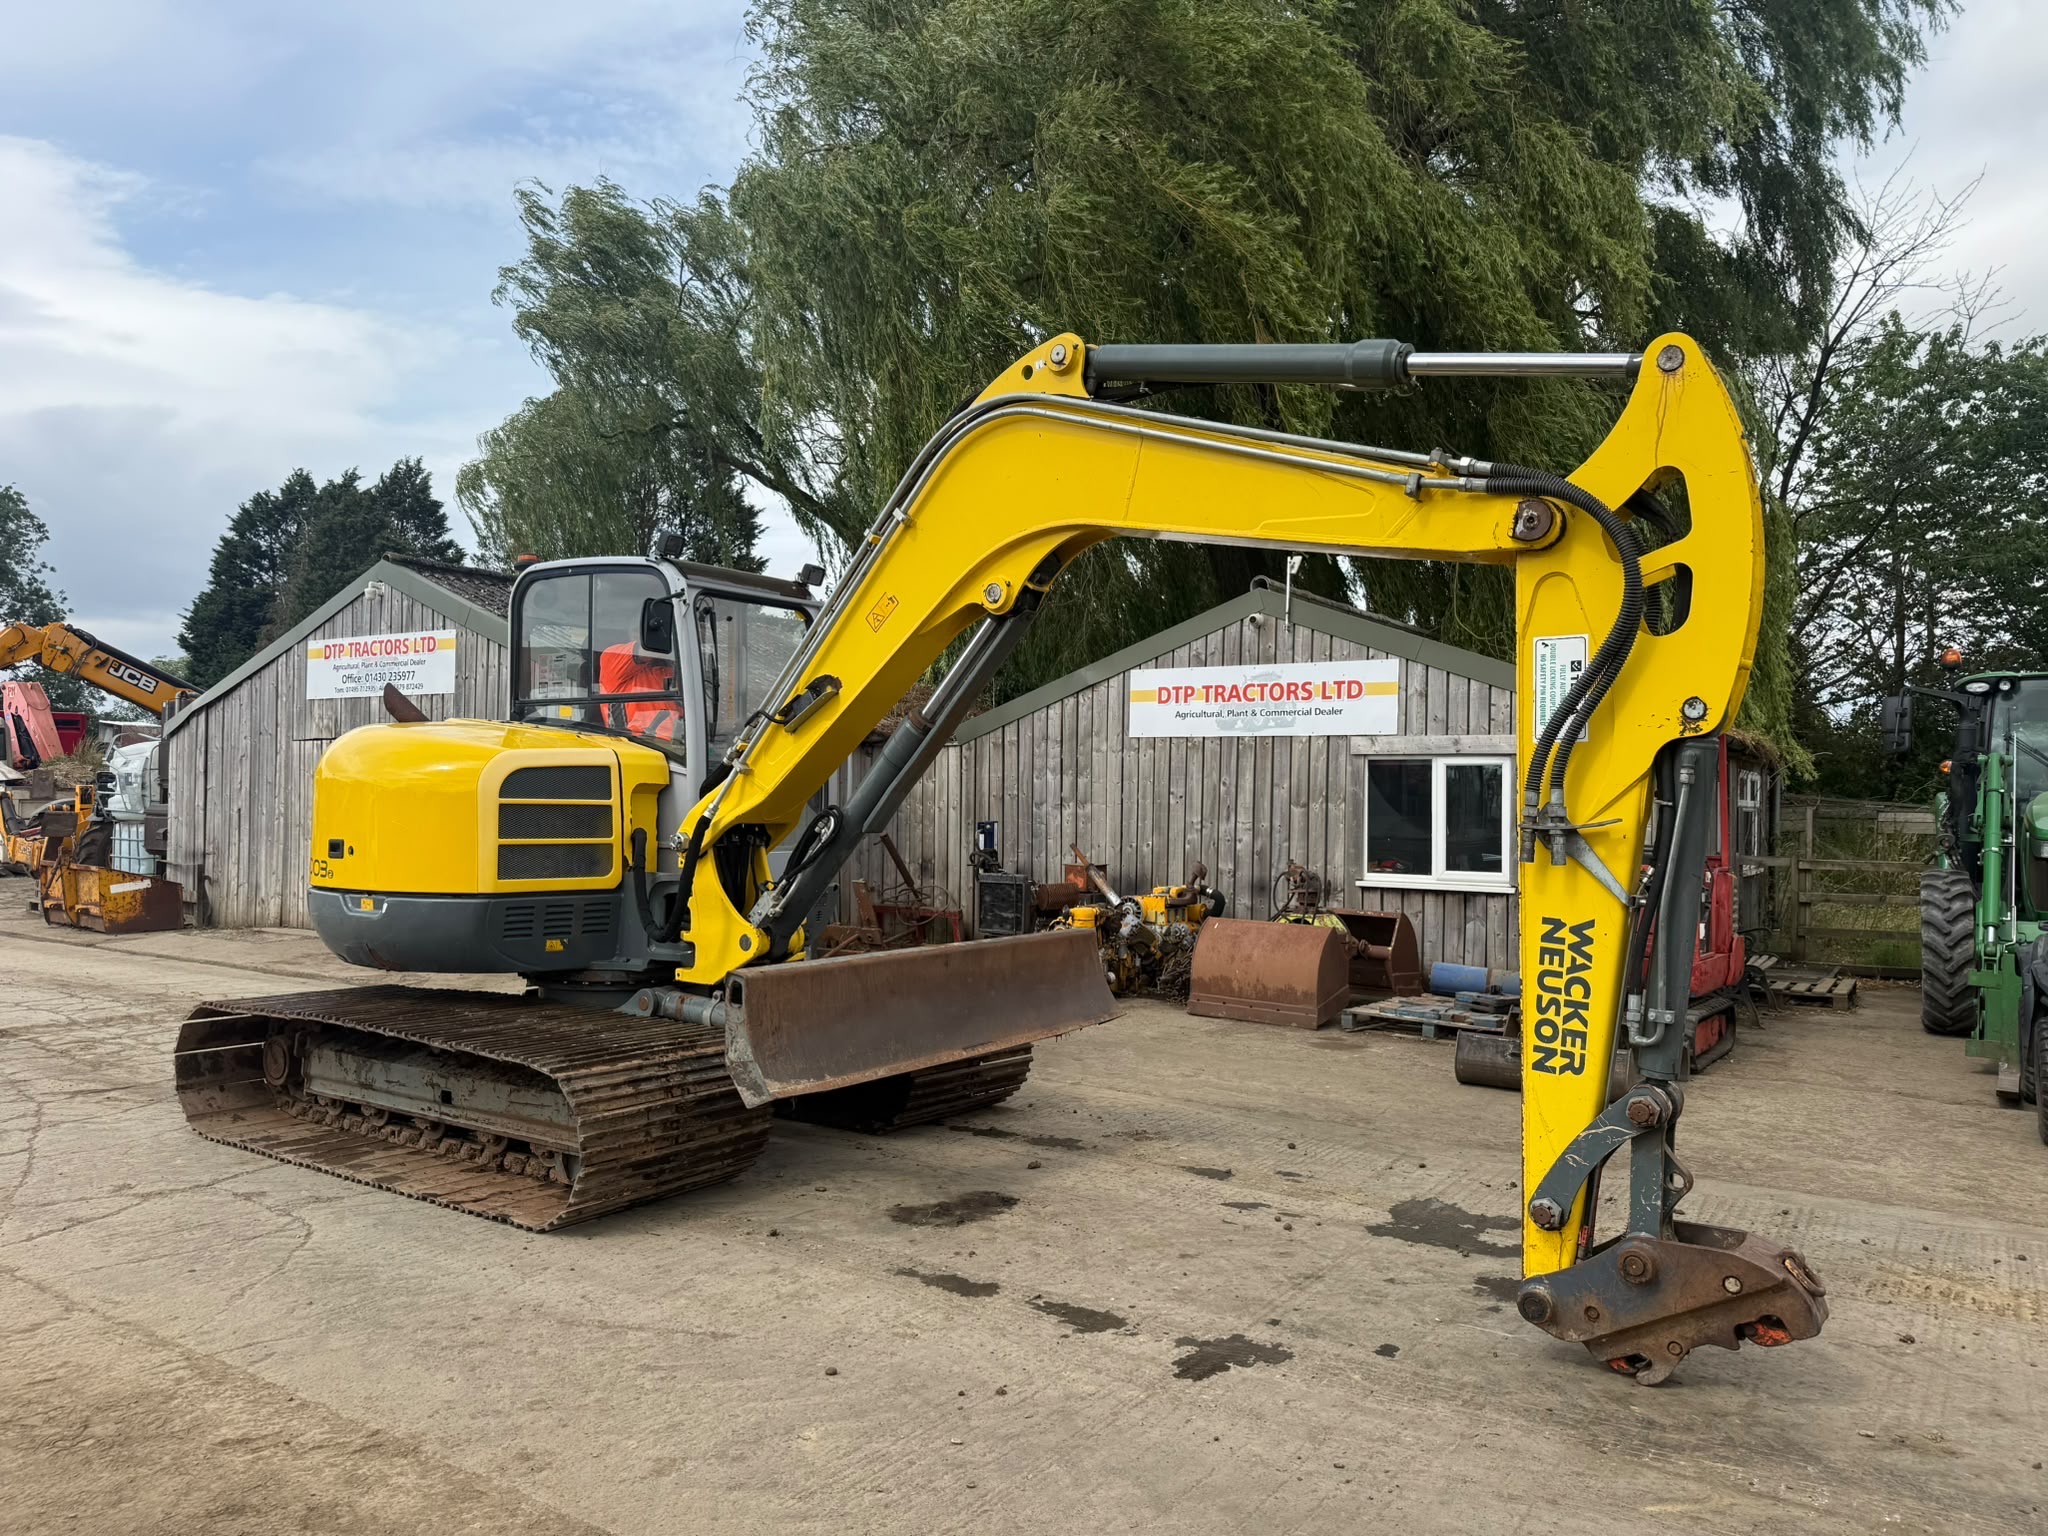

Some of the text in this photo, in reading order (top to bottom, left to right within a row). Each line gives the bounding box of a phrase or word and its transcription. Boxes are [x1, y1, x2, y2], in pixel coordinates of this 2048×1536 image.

[324, 636, 437, 660] DTP TRACTORS LTD
[361, 661, 374, 669] Plant
[379, 659, 409, 668] Commercial
[409, 658, 426, 666] Dealer
[108, 662, 158, 694] JCB
[342, 671, 416, 684] Office: 01430 235977
[1157, 680, 1364, 705] DTP TRACTORS LTD
[1175, 707, 1343, 719] Agricultural, Plant & Commercial Dealer
[1532, 916, 1567, 1075] NEUSON
[1559, 918, 1596, 1076] WACKER
